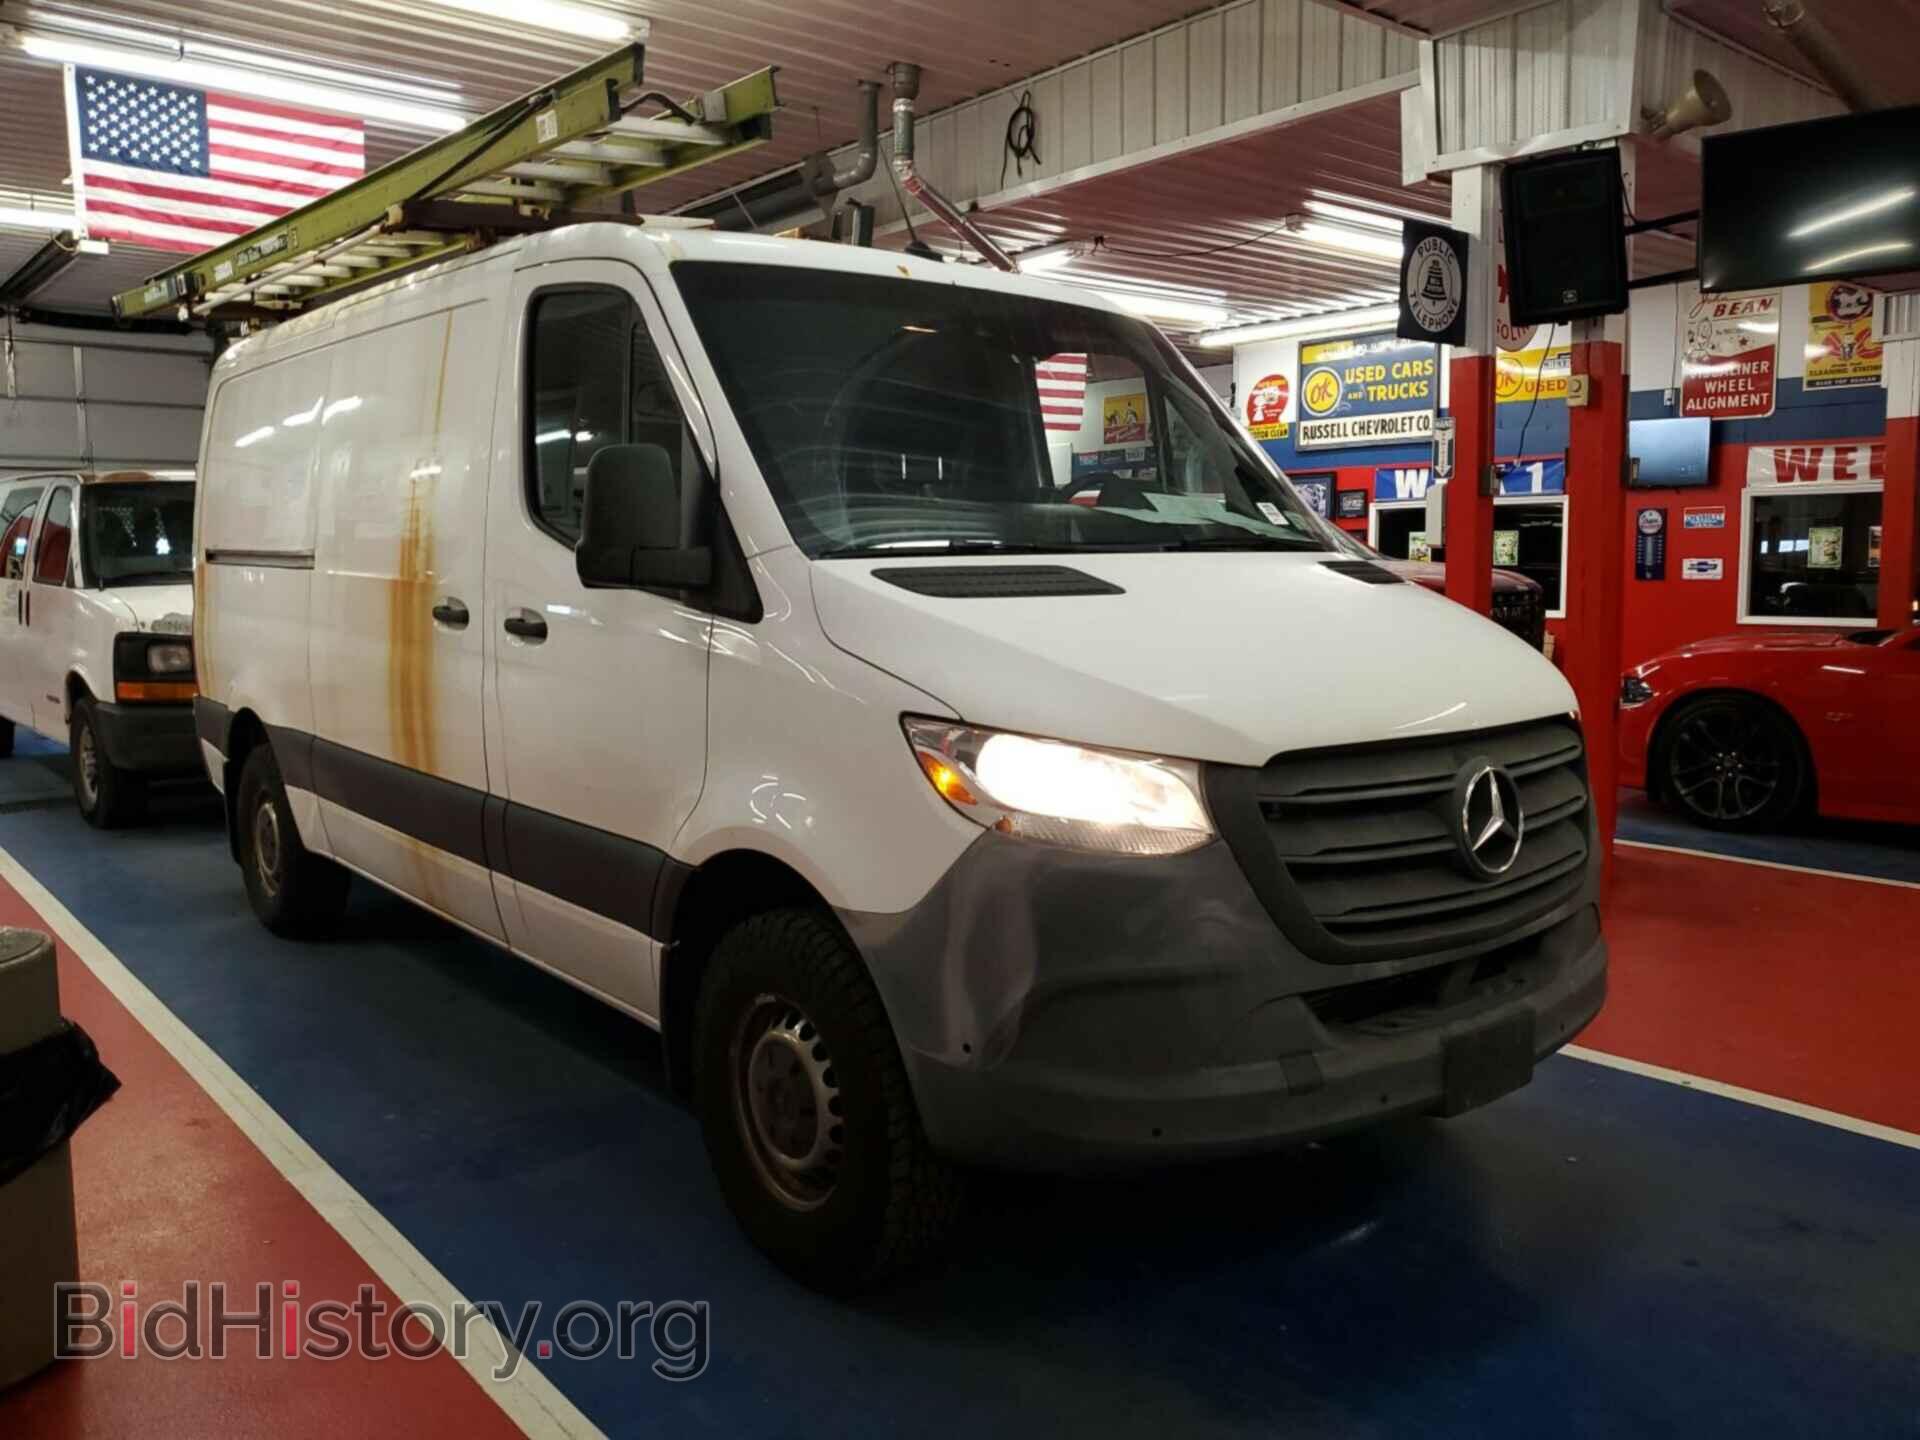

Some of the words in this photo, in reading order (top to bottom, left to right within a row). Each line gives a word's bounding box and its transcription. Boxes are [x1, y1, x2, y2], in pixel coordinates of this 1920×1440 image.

[1417, 239, 1454, 265] PUBLIC
[1409, 290, 1458, 329] TELEPHONE
[1713, 297, 1774, 318] BEAN
[1344, 365, 1386, 384] USED
[1391, 358, 1434, 379] CARS
[1310, 379, 1332, 405] OK
[1367, 380, 1429, 402] TRUCKS
[1525, 379, 1567, 393] USED
[1705, 378, 1755, 394] WHEEL
[1686, 393, 1769, 411] ALIGNMENT
[1303, 422, 1348, 441] RUSSELL
[1352, 416, 1413, 436] CHEVROLET
[1416, 415, 1431, 431] CO.
